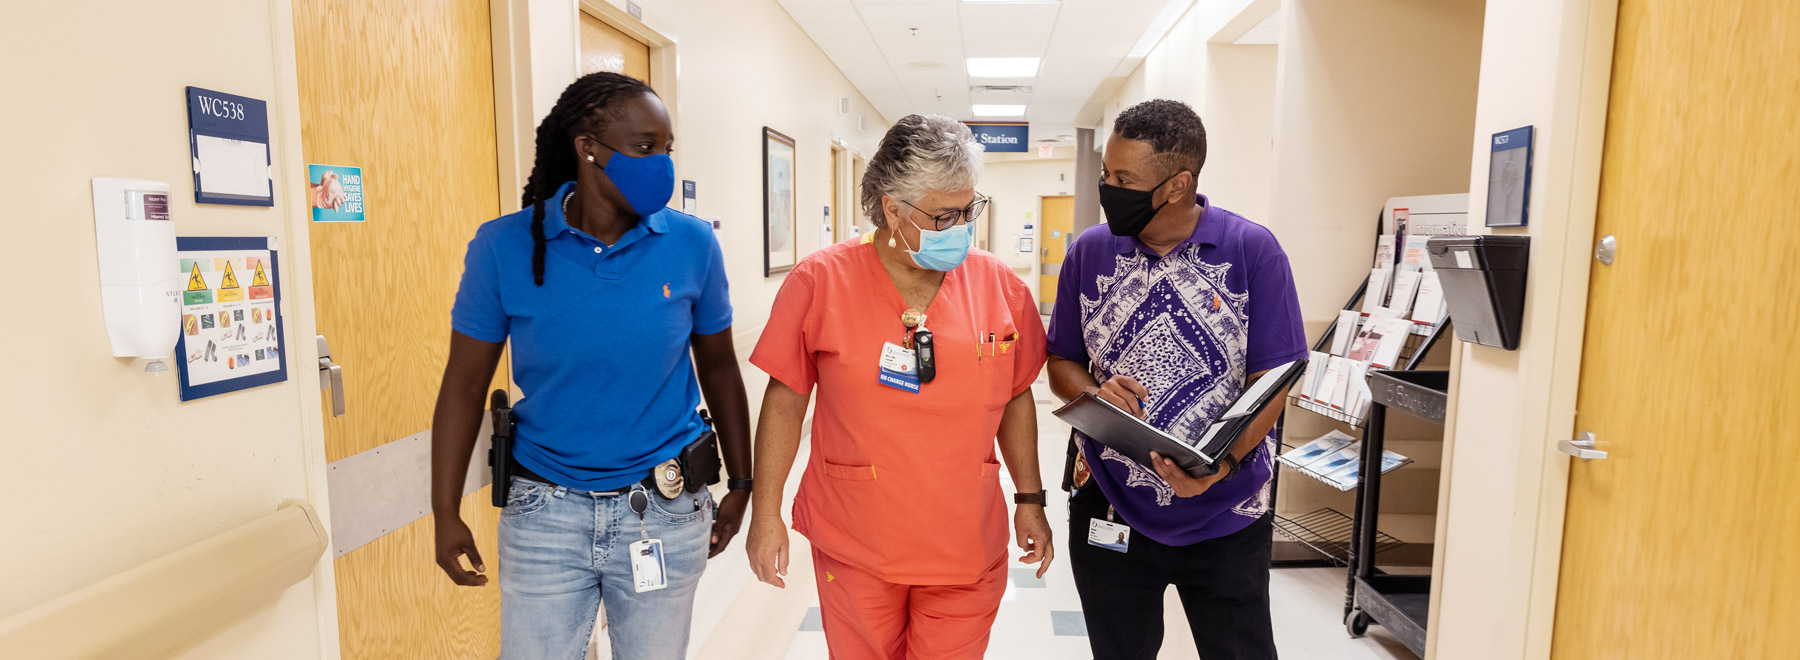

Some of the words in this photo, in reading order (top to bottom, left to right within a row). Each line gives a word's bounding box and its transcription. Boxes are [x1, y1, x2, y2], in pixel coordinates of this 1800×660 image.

[198, 95, 245, 121] WC538
[981, 133, 1018, 144] Station
[342, 174, 360, 185] HAND
[343, 192, 362, 202] SAVES
[344, 202, 363, 213] LIVES
[887, 376, 904, 386] CHARGE
[904, 381, 919, 391] NURSE
